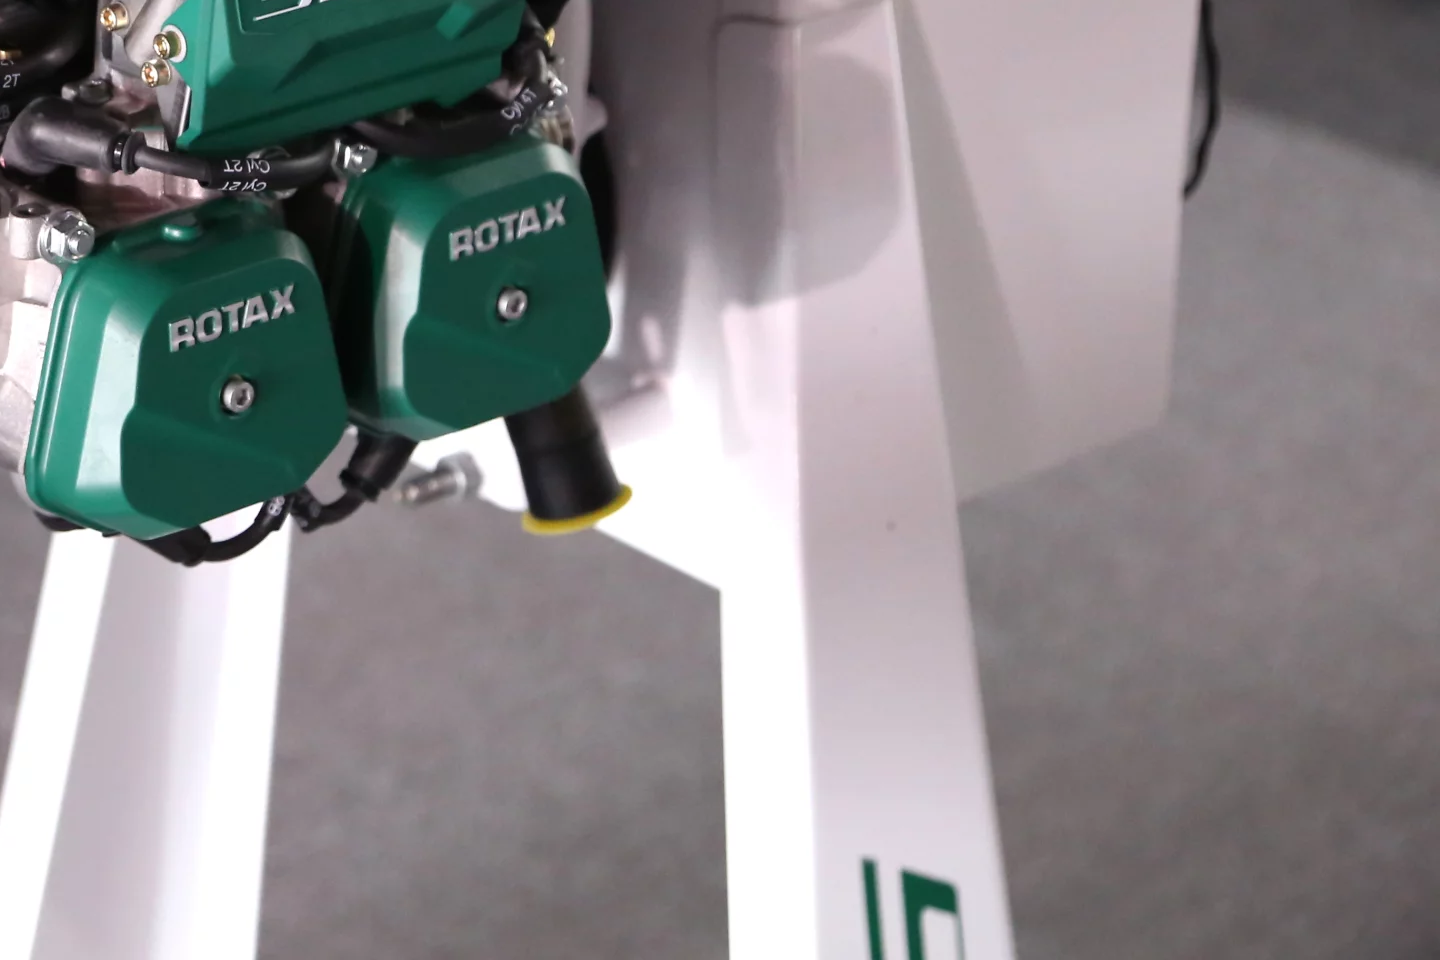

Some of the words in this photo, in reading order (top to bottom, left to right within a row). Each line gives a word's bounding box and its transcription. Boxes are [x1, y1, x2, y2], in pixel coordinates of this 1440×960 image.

[2, 72, 21, 89] 2T
[223, 159, 243, 173] 2T
[246, 158, 271, 174] Cyl
[217, 180, 242, 191] 2T
[241, 178, 267, 192] Cyl
[449, 195, 567, 262] ROTAX
[168, 284, 297, 352] ROTAX
